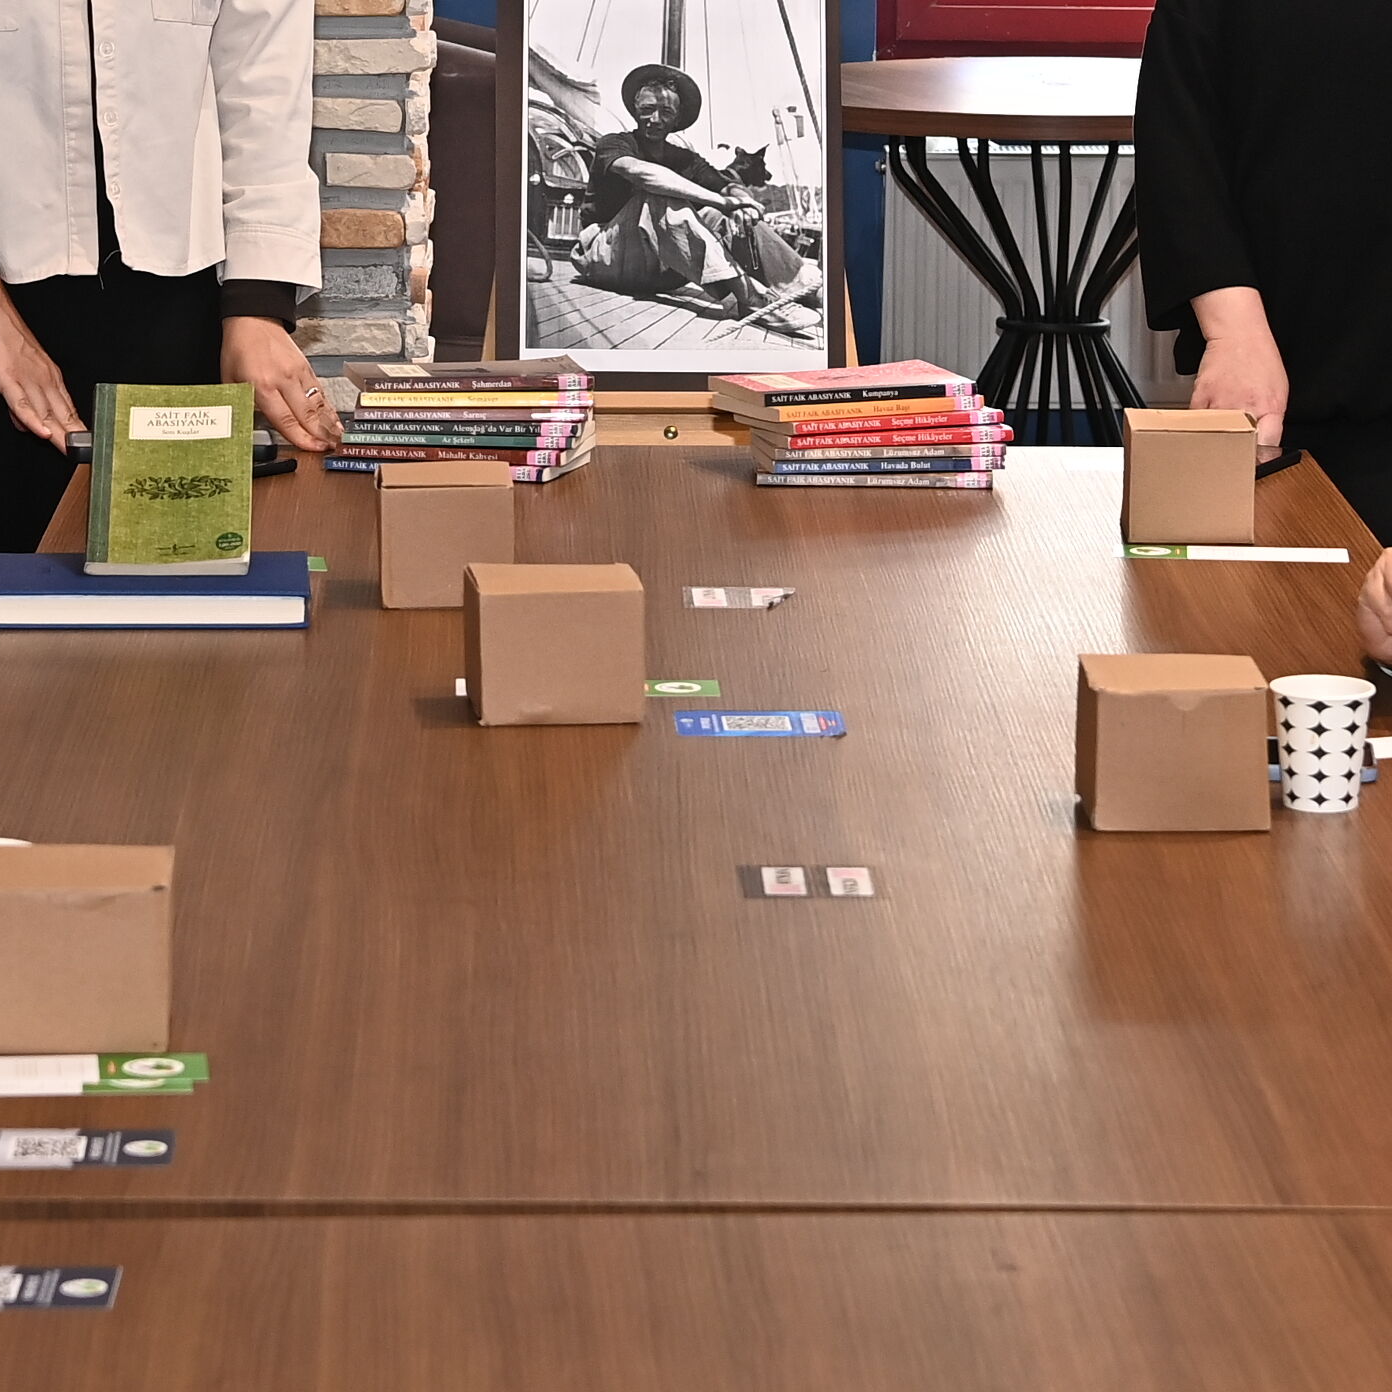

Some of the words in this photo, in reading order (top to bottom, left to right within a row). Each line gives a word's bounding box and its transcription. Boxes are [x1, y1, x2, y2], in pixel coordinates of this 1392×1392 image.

[375, 382, 392, 390] SAİT
[393, 381, 411, 389] FAİK
[413, 381, 460, 389] ABASIYANIK
[471, 380, 512, 390] Şahmerdan
[771, 393, 788, 403] SAİT
[789, 392, 806, 402] FAİK
[808, 392, 851, 400] ABASIYANIK
[862, 389, 899, 399] Kumpanya
[155, 411, 181, 419] SAİT
[184, 410, 210, 419] FAİK
[364, 411, 382, 419] SAİT
[383, 411, 402, 419] FAİK
[403, 411, 451, 419] ABASIYANIK
[463, 410, 487, 419] Sarnıç
[147, 419, 217, 427] ABASIYANIK
[354, 423, 372, 431] SAİT
[373, 422, 391, 431] FAİK
[394, 424, 441, 432] ABASIYANIK
[498, 425, 513, 433] Var
[514, 425, 526, 433] Bir
[529, 425, 541, 433] Yıl
[801, 423, 819, 432] SAİT
[819, 422, 837, 431] FAİK
[838, 421, 881, 429] ABASIYANIK
[891, 417, 914, 427] Seçme
[915, 415, 948, 425] Hikâyeler
[796, 438, 814, 446] SAİT
[815, 437, 833, 446] FAİK
[834, 436, 881, 445] ABASIYANIK
[892, 433, 916, 444] Seçme
[917, 432, 953, 443] Hikâyeler
[342, 448, 360, 456] SAİT
[361, 448, 379, 457] FAİK
[381, 450, 426, 458] ABASIYANIK
[437, 451, 467, 459] Mahalle
[469, 452, 498, 461] Kahvesi
[785, 449, 803, 458] SAİT
[804, 448, 822, 458] FAİK
[824, 449, 872, 458] ABASIYANIK
[923, 448, 945, 456] Adam
[332, 460, 349, 469] SAİT
[350, 460, 368, 470] FAİK
[782, 463, 800, 472] SAİT
[801, 462, 819, 471] FAİK
[821, 463, 869, 471] ABASIYANIK
[880, 461, 909, 470] Havada
[910, 460, 931, 469] Bulut
[767, 475, 786, 484] SAİT
[787, 474, 806, 484] FAİK
[807, 476, 856, 485] ABASIYANIK
[907, 477, 930, 487] Adam
